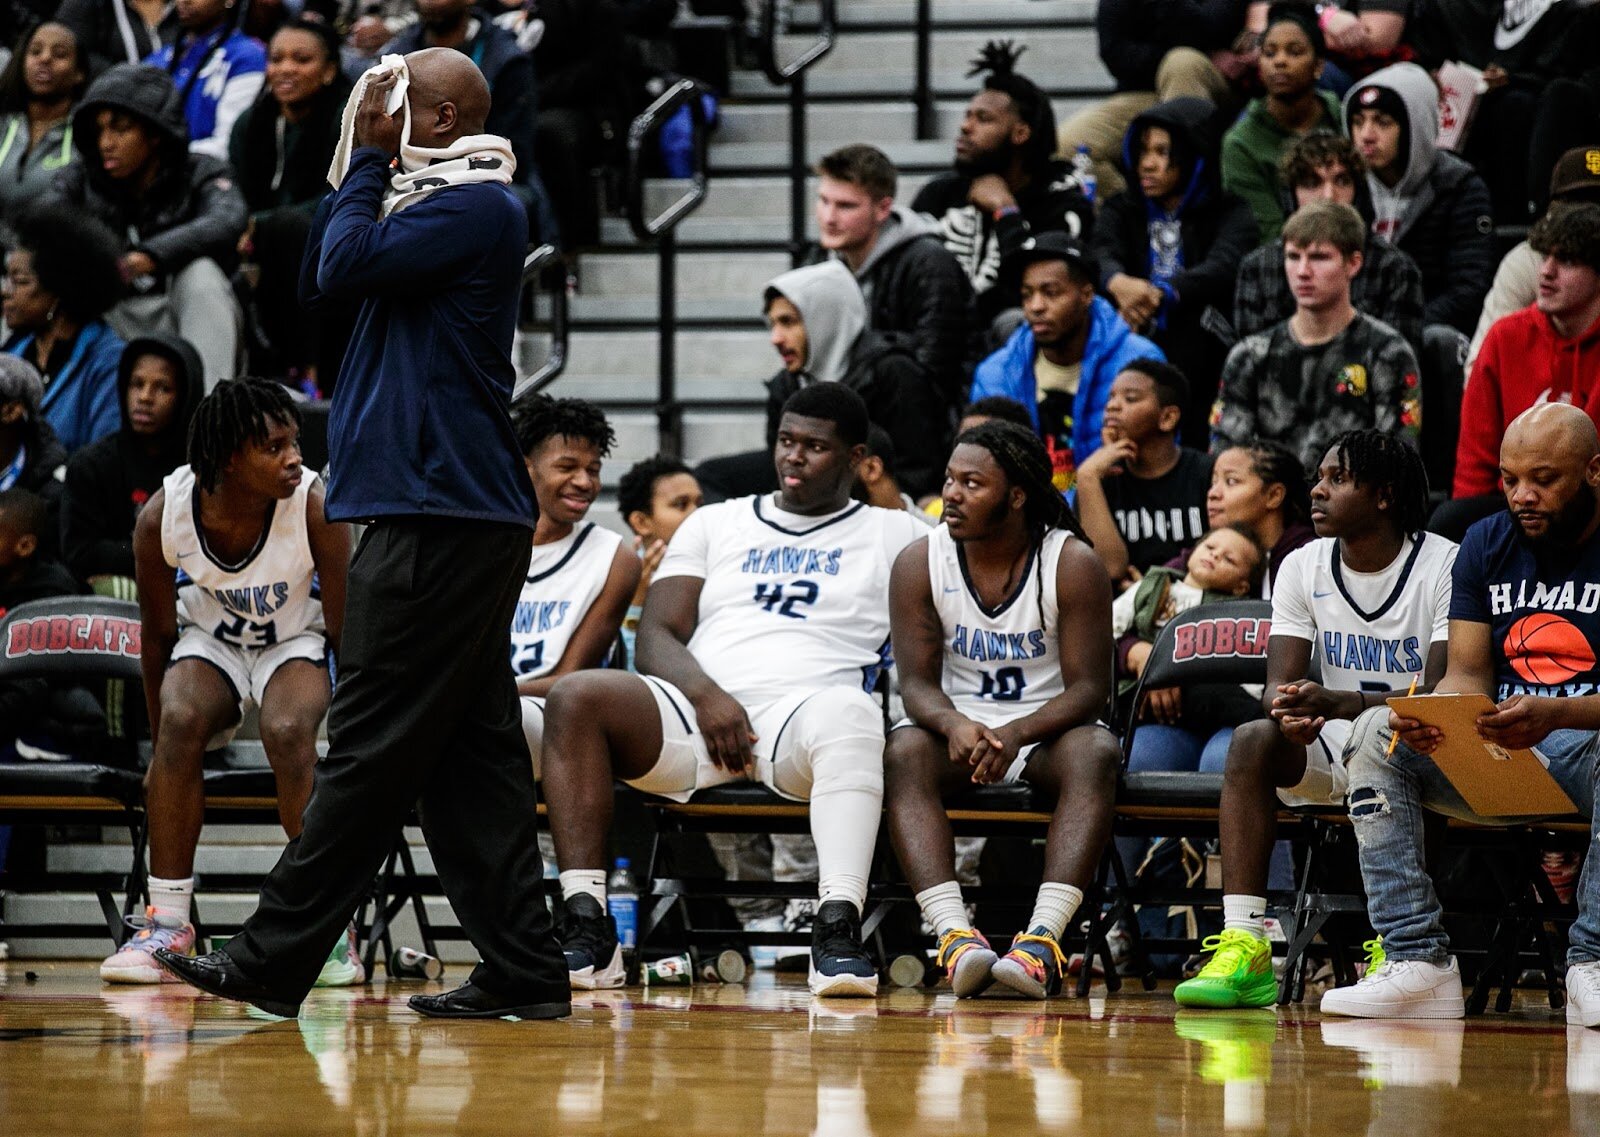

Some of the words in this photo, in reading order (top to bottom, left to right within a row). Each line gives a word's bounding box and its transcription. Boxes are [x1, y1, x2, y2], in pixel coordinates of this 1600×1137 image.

[741, 546, 843, 576] HAWKS
[511, 599, 571, 634] WKS
[753, 579, 819, 619] 42
[6, 614, 142, 659] BOBCATS
[952, 623, 1047, 662] HAWKS
[1173, 618, 1272, 663] BOBCA
[1324, 630, 1423, 674] HAWKS
[976, 666, 1027, 701] 10
